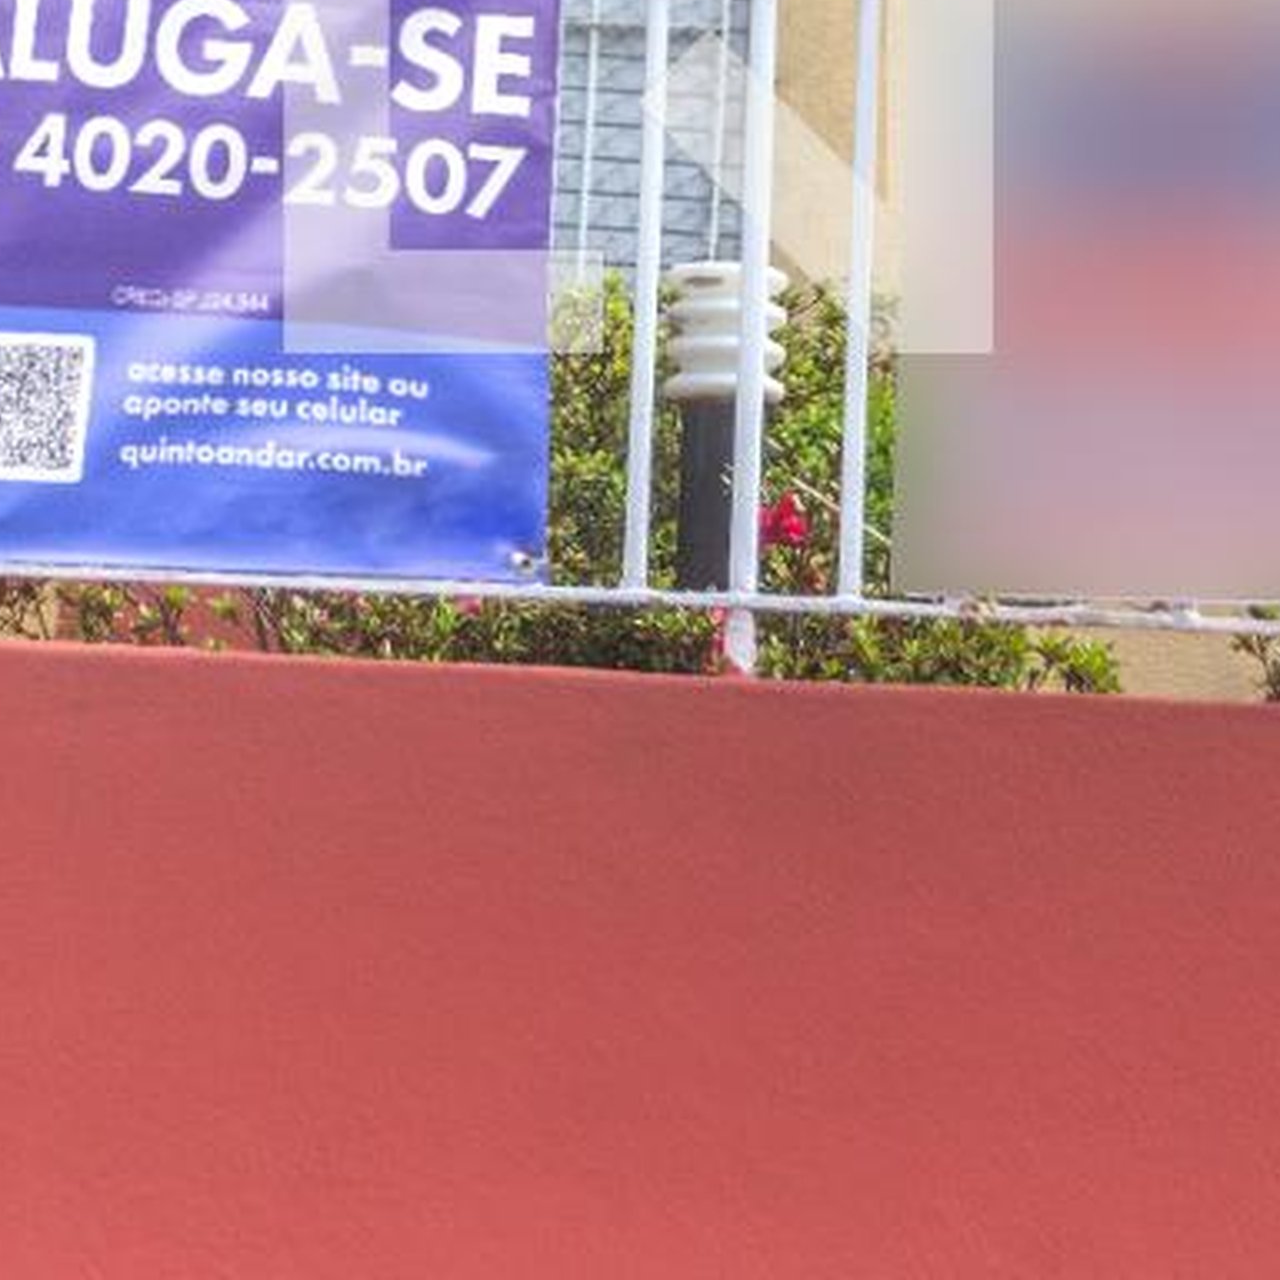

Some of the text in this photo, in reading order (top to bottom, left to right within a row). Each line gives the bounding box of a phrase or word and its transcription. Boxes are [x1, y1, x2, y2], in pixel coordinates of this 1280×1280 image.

[14, 113, 527, 219] 4020-2507
[127, 362, 429, 399] acesse nosso site ou
[122, 392, 403, 426] aponte seu celular
[119, 436, 429, 477] quintoandar.com.br
